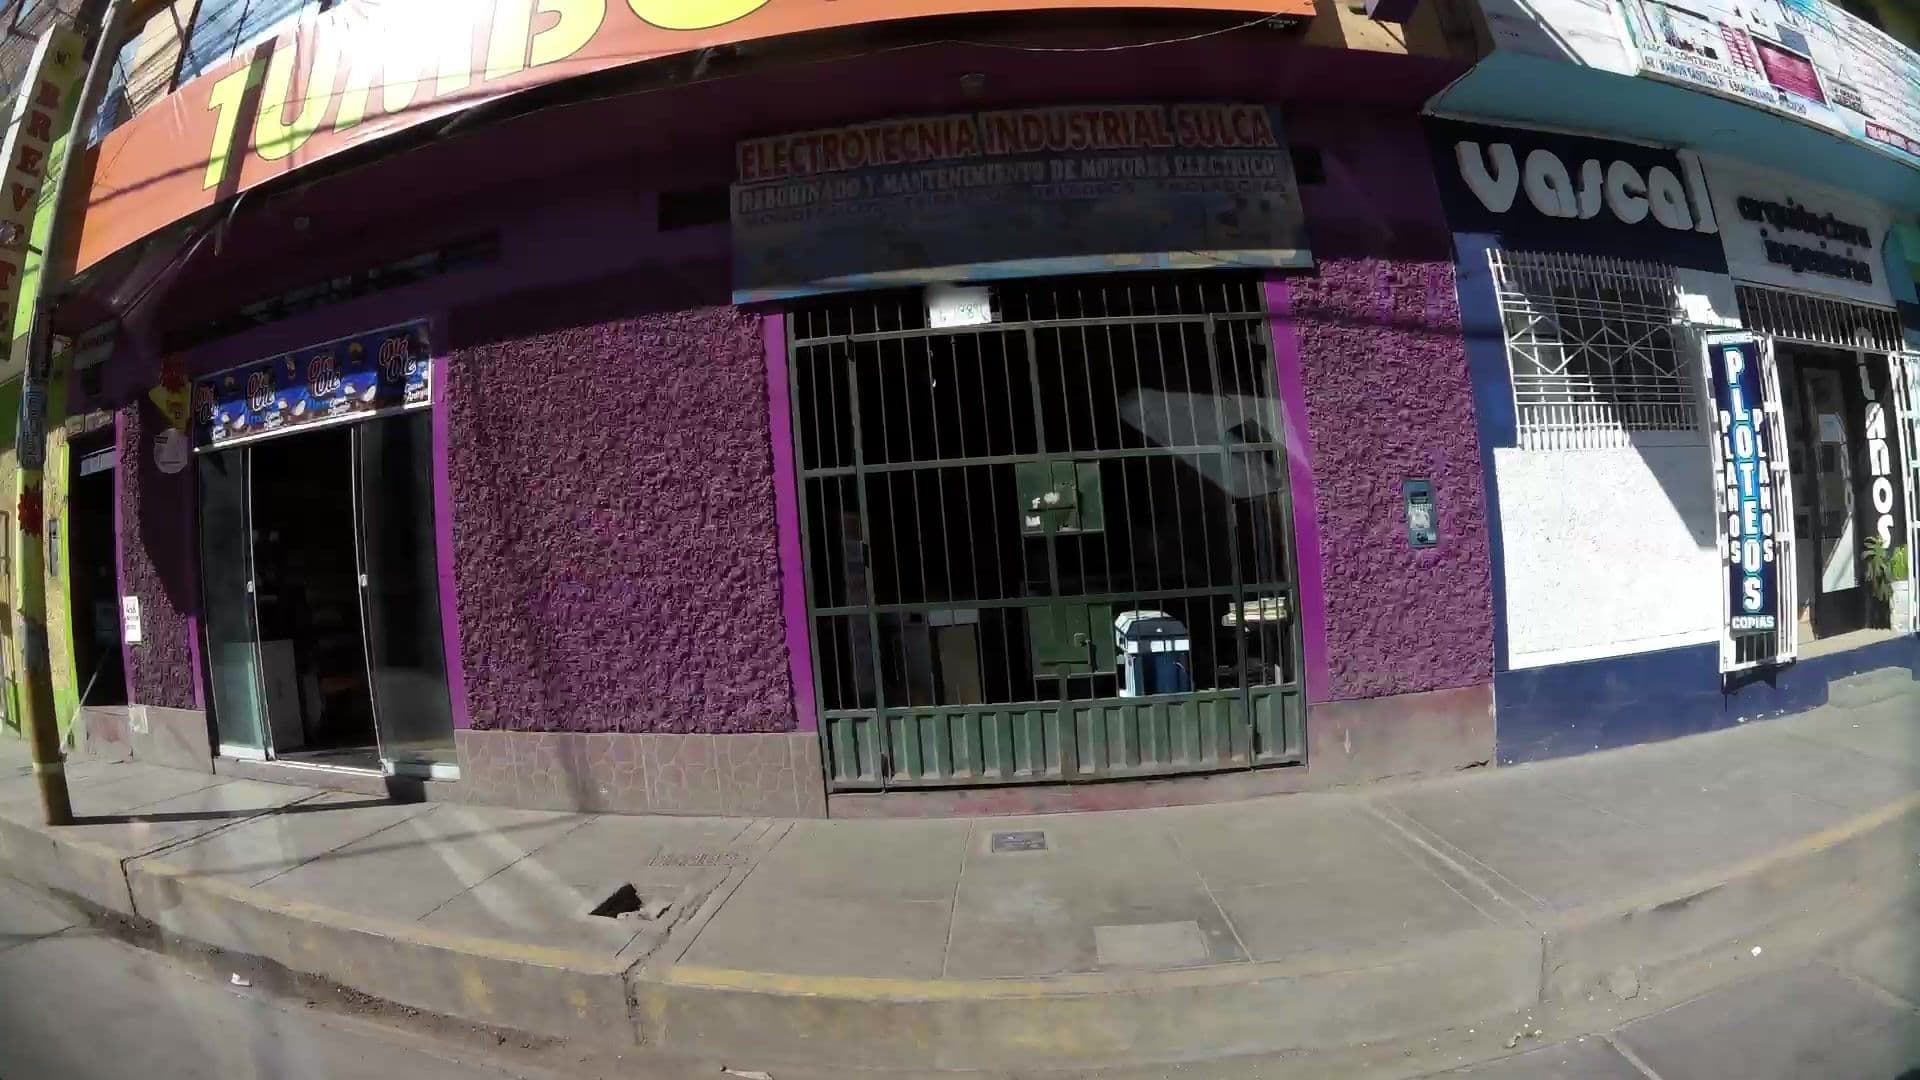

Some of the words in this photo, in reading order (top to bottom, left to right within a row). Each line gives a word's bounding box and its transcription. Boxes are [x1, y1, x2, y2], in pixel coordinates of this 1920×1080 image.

[740, 117, 978, 178] ELECTROTECNIA
[985, 109, 1170, 155] INDUSTRIAL
[1175, 108, 1276, 146] SULCA
[1724, 347, 1762, 612] PLOTEOS
[1731, 615, 1775, 630] COPIAS
